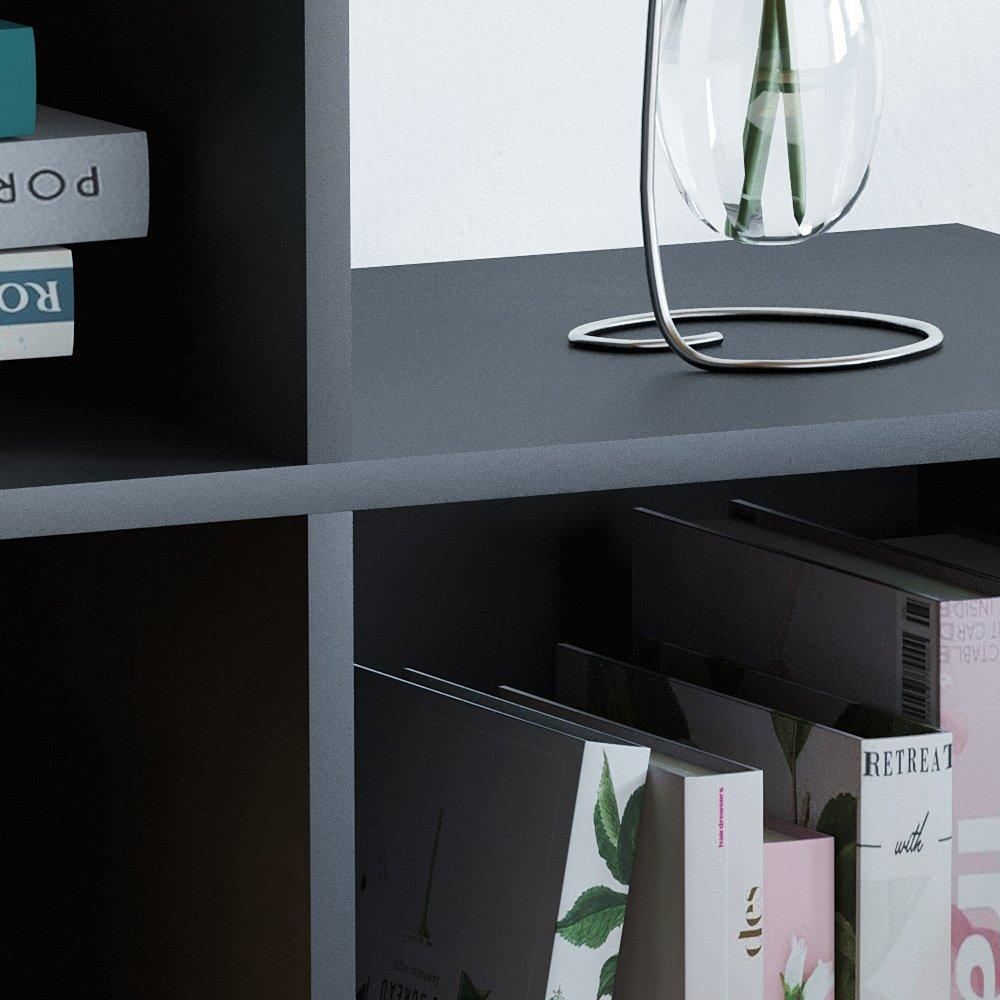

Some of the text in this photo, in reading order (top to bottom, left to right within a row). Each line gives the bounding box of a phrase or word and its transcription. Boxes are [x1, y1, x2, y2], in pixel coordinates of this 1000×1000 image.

[0, 280, 62, 313] RO
[863, 743, 952, 777] RETREAT
[894, 811, 930, 855] with
[738, 885, 763, 957] des
